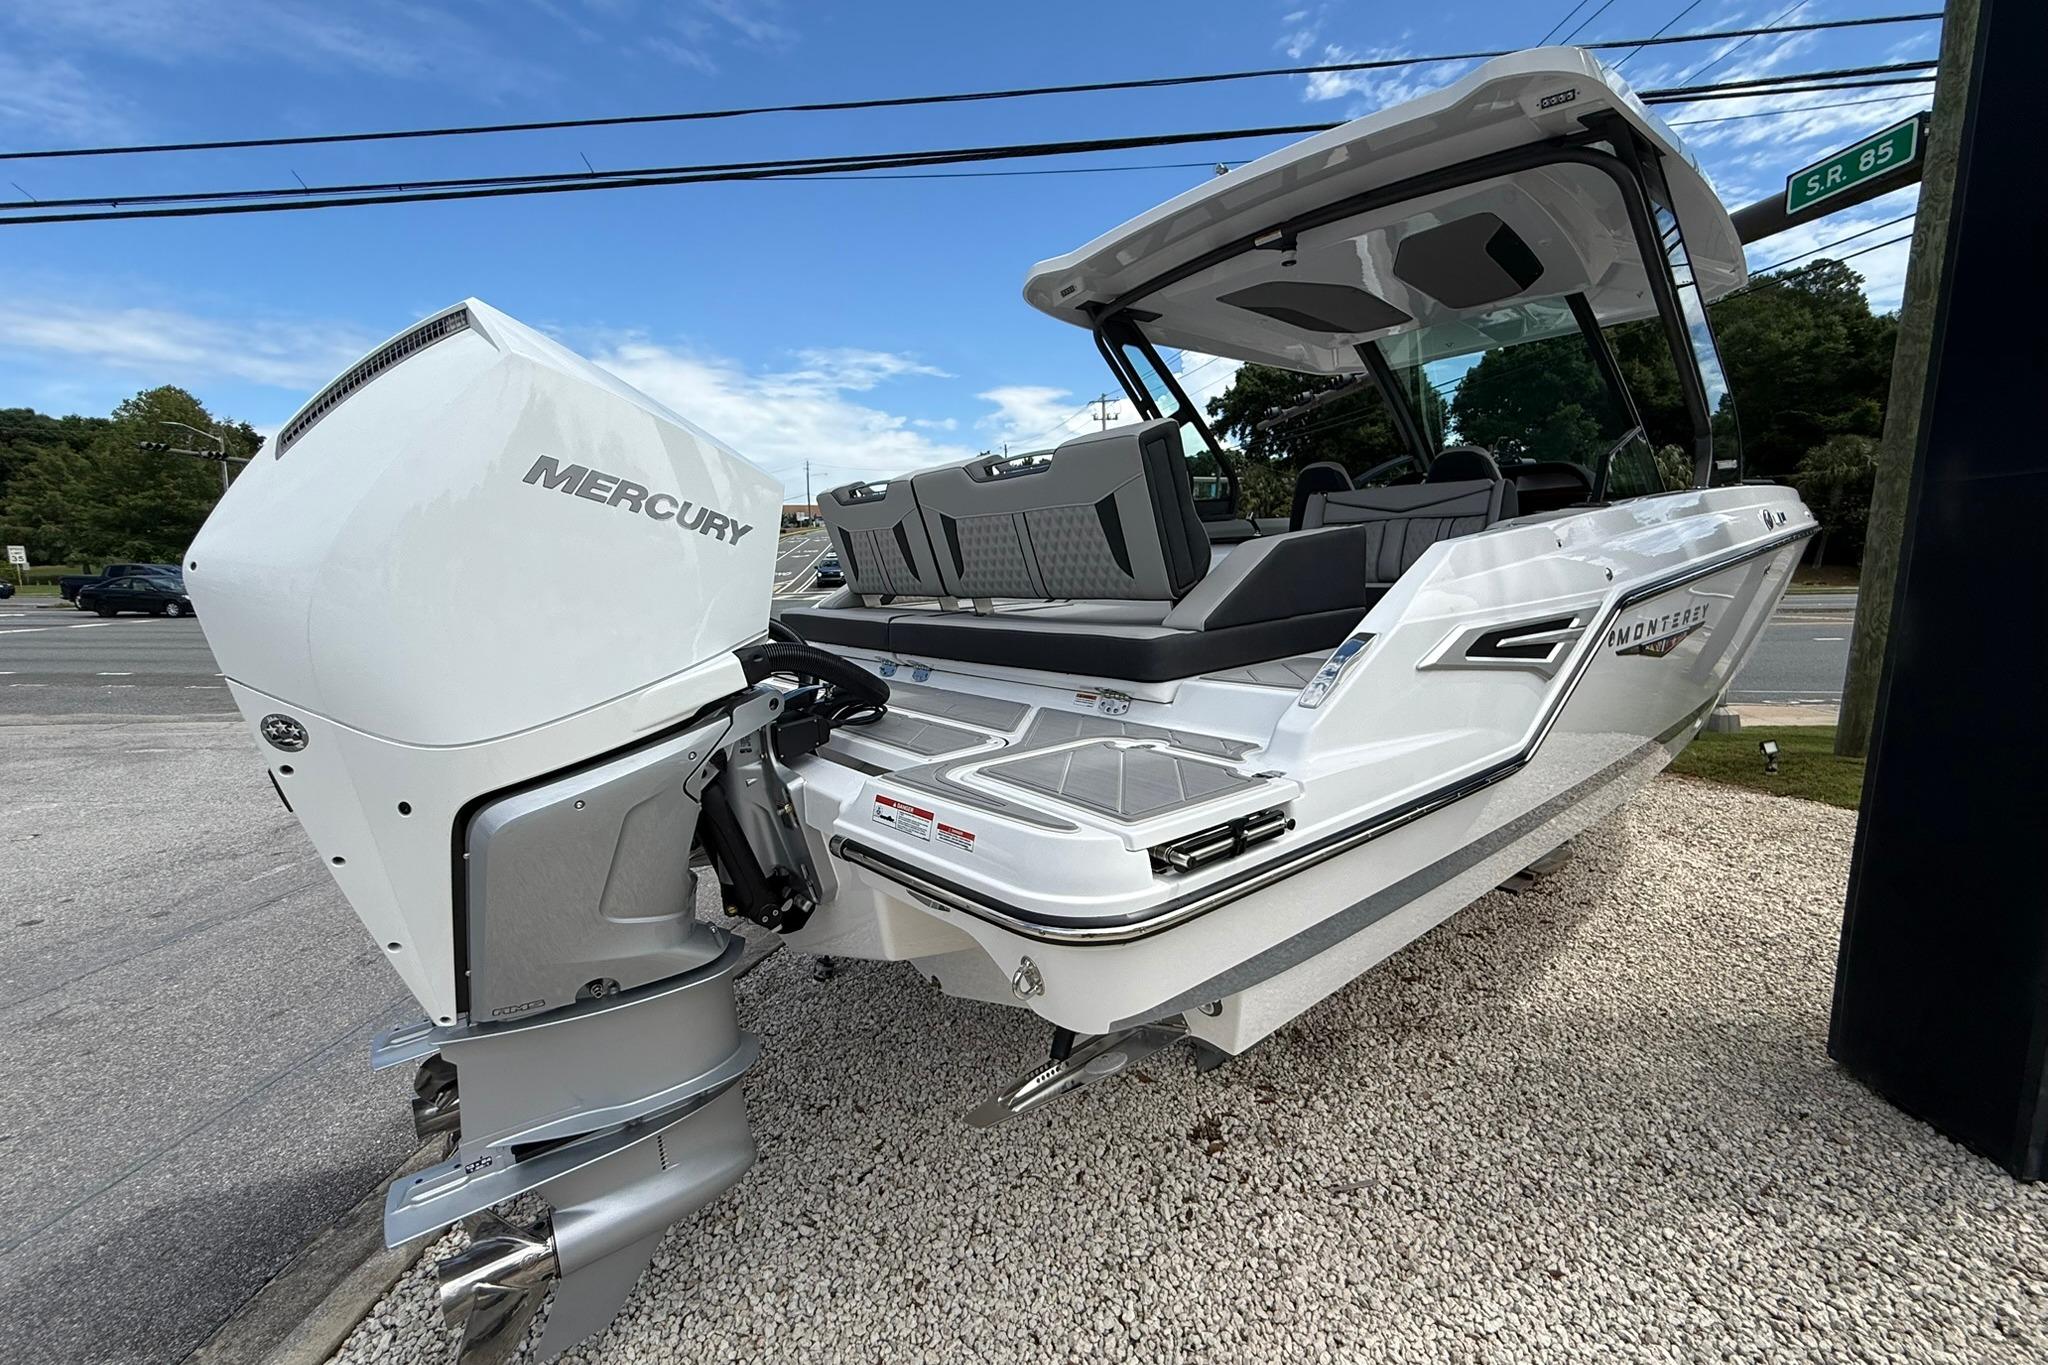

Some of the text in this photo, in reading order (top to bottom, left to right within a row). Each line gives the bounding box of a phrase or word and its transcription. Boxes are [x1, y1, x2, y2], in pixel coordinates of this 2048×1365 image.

[1806, 139, 1893, 196] S.R. 85
[522, 454, 753, 546] MERCURY
[1616, 603, 1710, 647] MONTEREY
